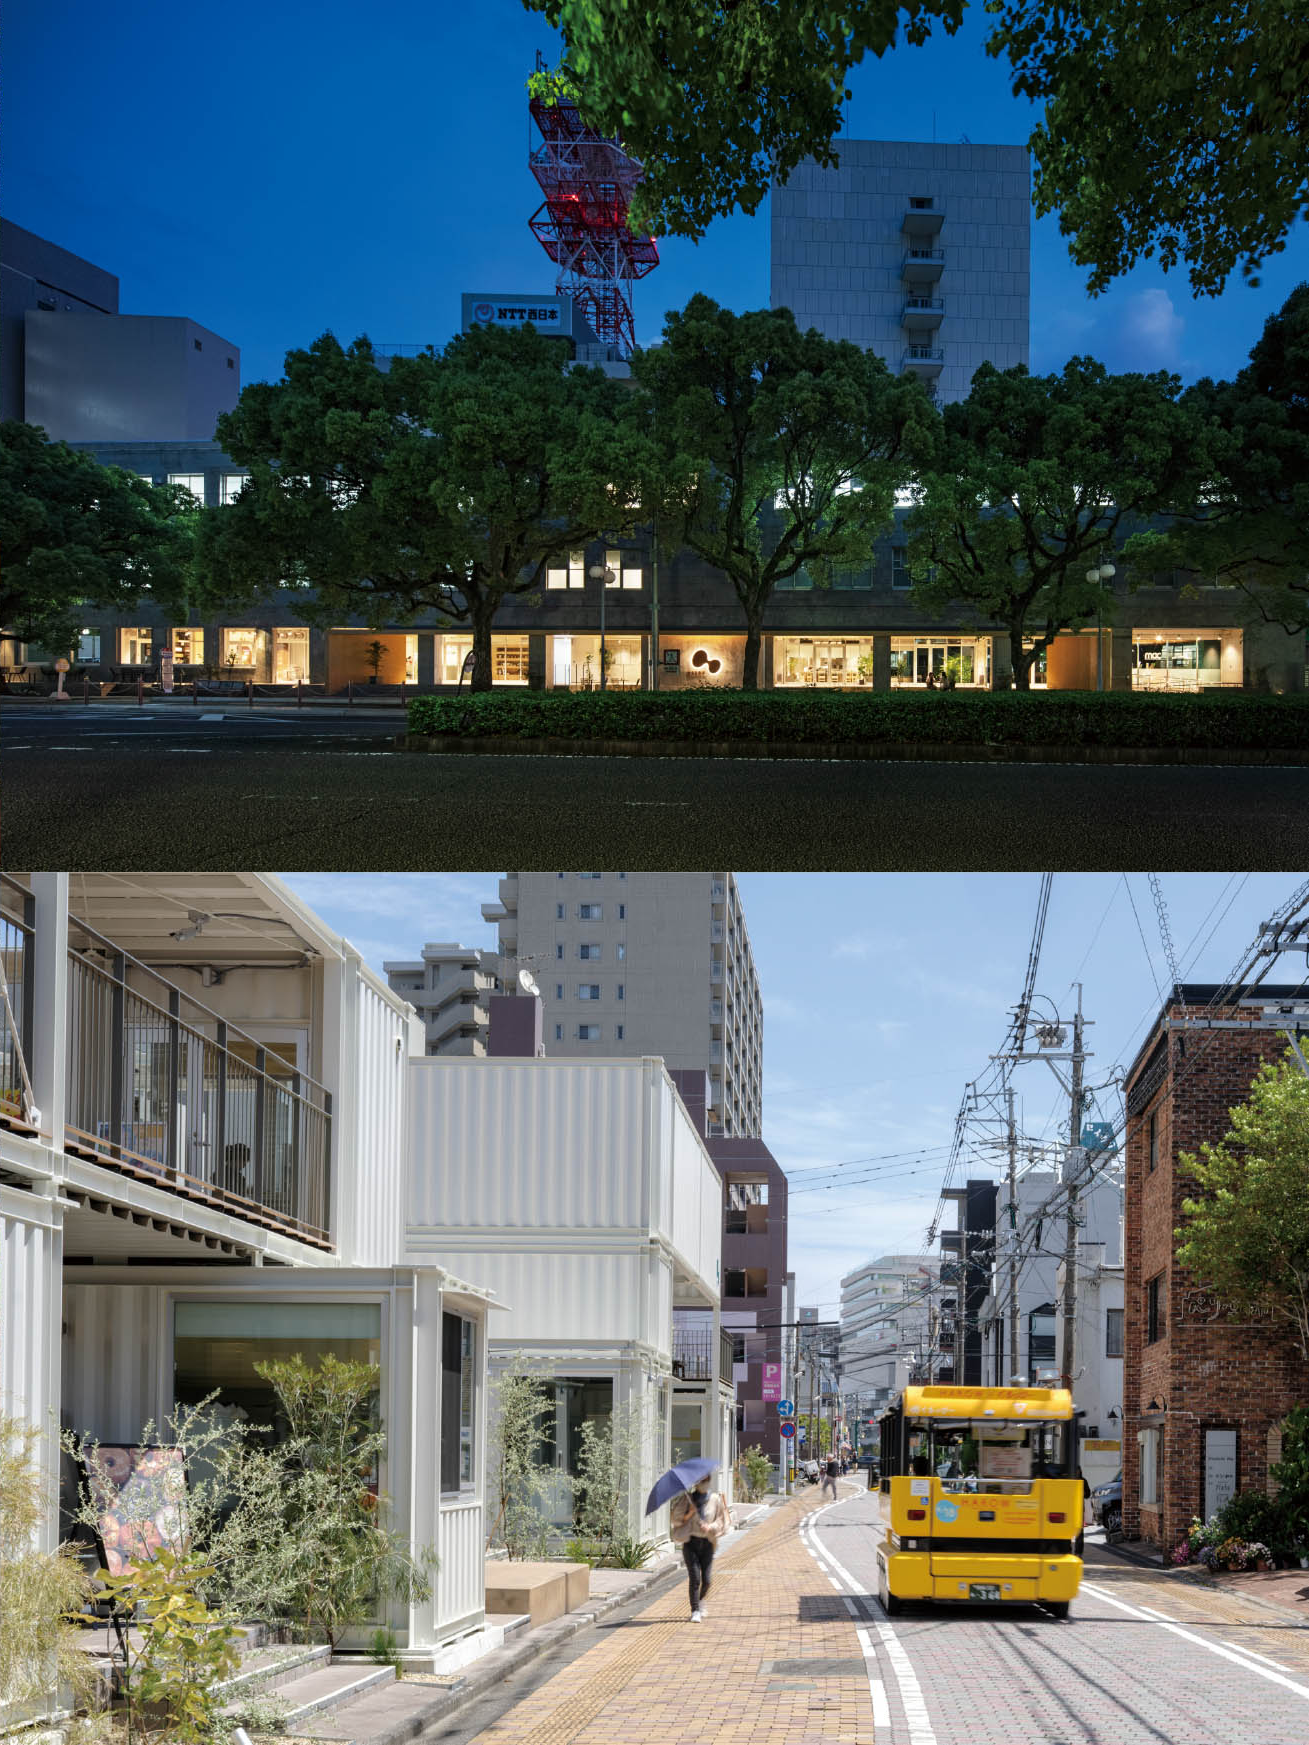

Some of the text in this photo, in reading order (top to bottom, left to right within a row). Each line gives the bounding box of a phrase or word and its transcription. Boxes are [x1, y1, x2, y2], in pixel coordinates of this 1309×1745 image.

[498, 308, 558, 320] NTT西日本
[766, 1365, 778, 1378] P
